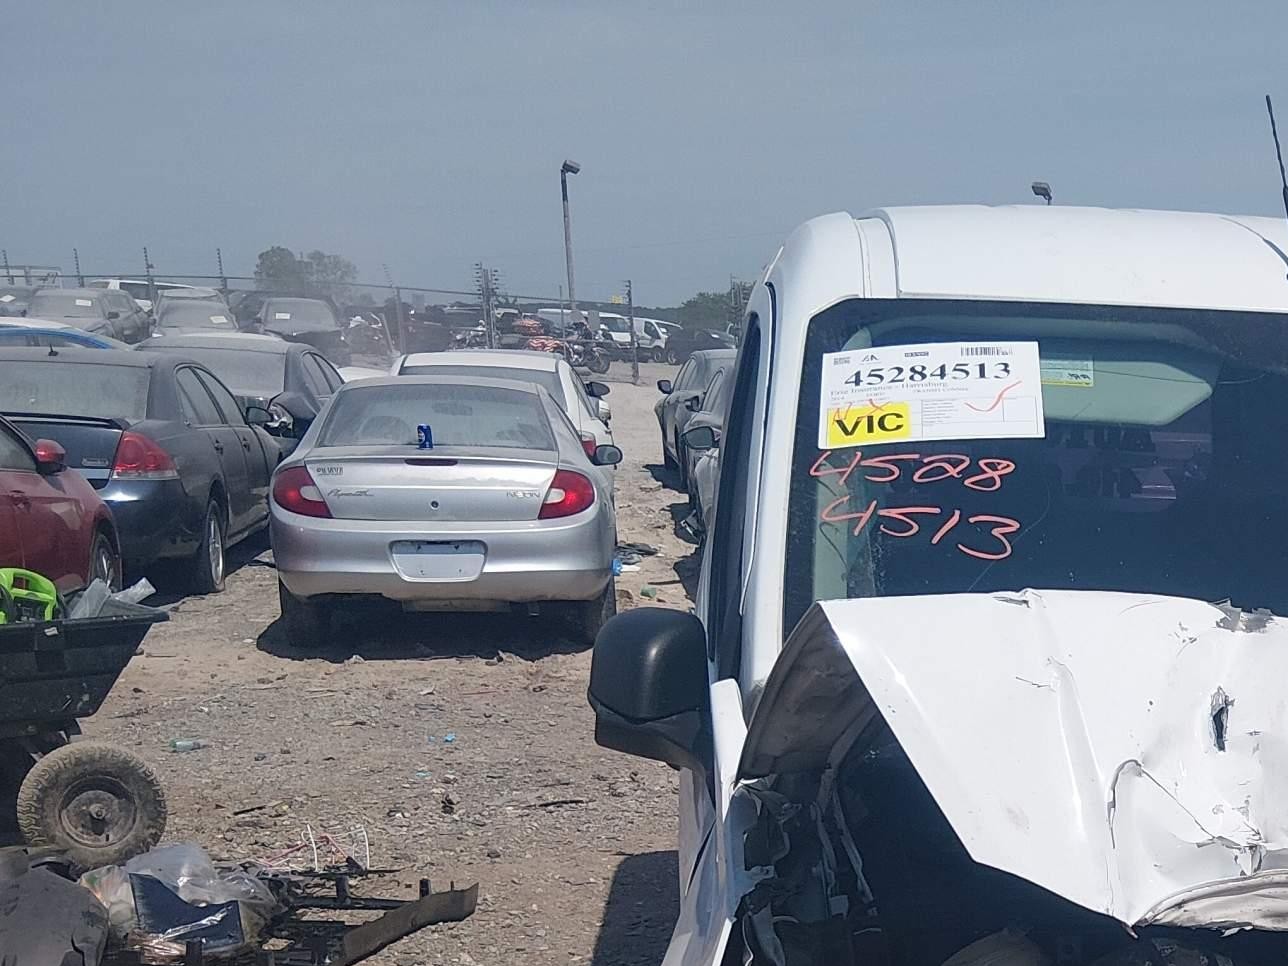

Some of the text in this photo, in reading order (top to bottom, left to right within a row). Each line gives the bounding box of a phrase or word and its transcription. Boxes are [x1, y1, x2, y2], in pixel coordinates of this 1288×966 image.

[844, 362, 1011, 387] 45284513
[836, 413, 904, 436] VIC
[809, 451, 1015, 491] 4528
[820, 495, 1021, 560] 4513
